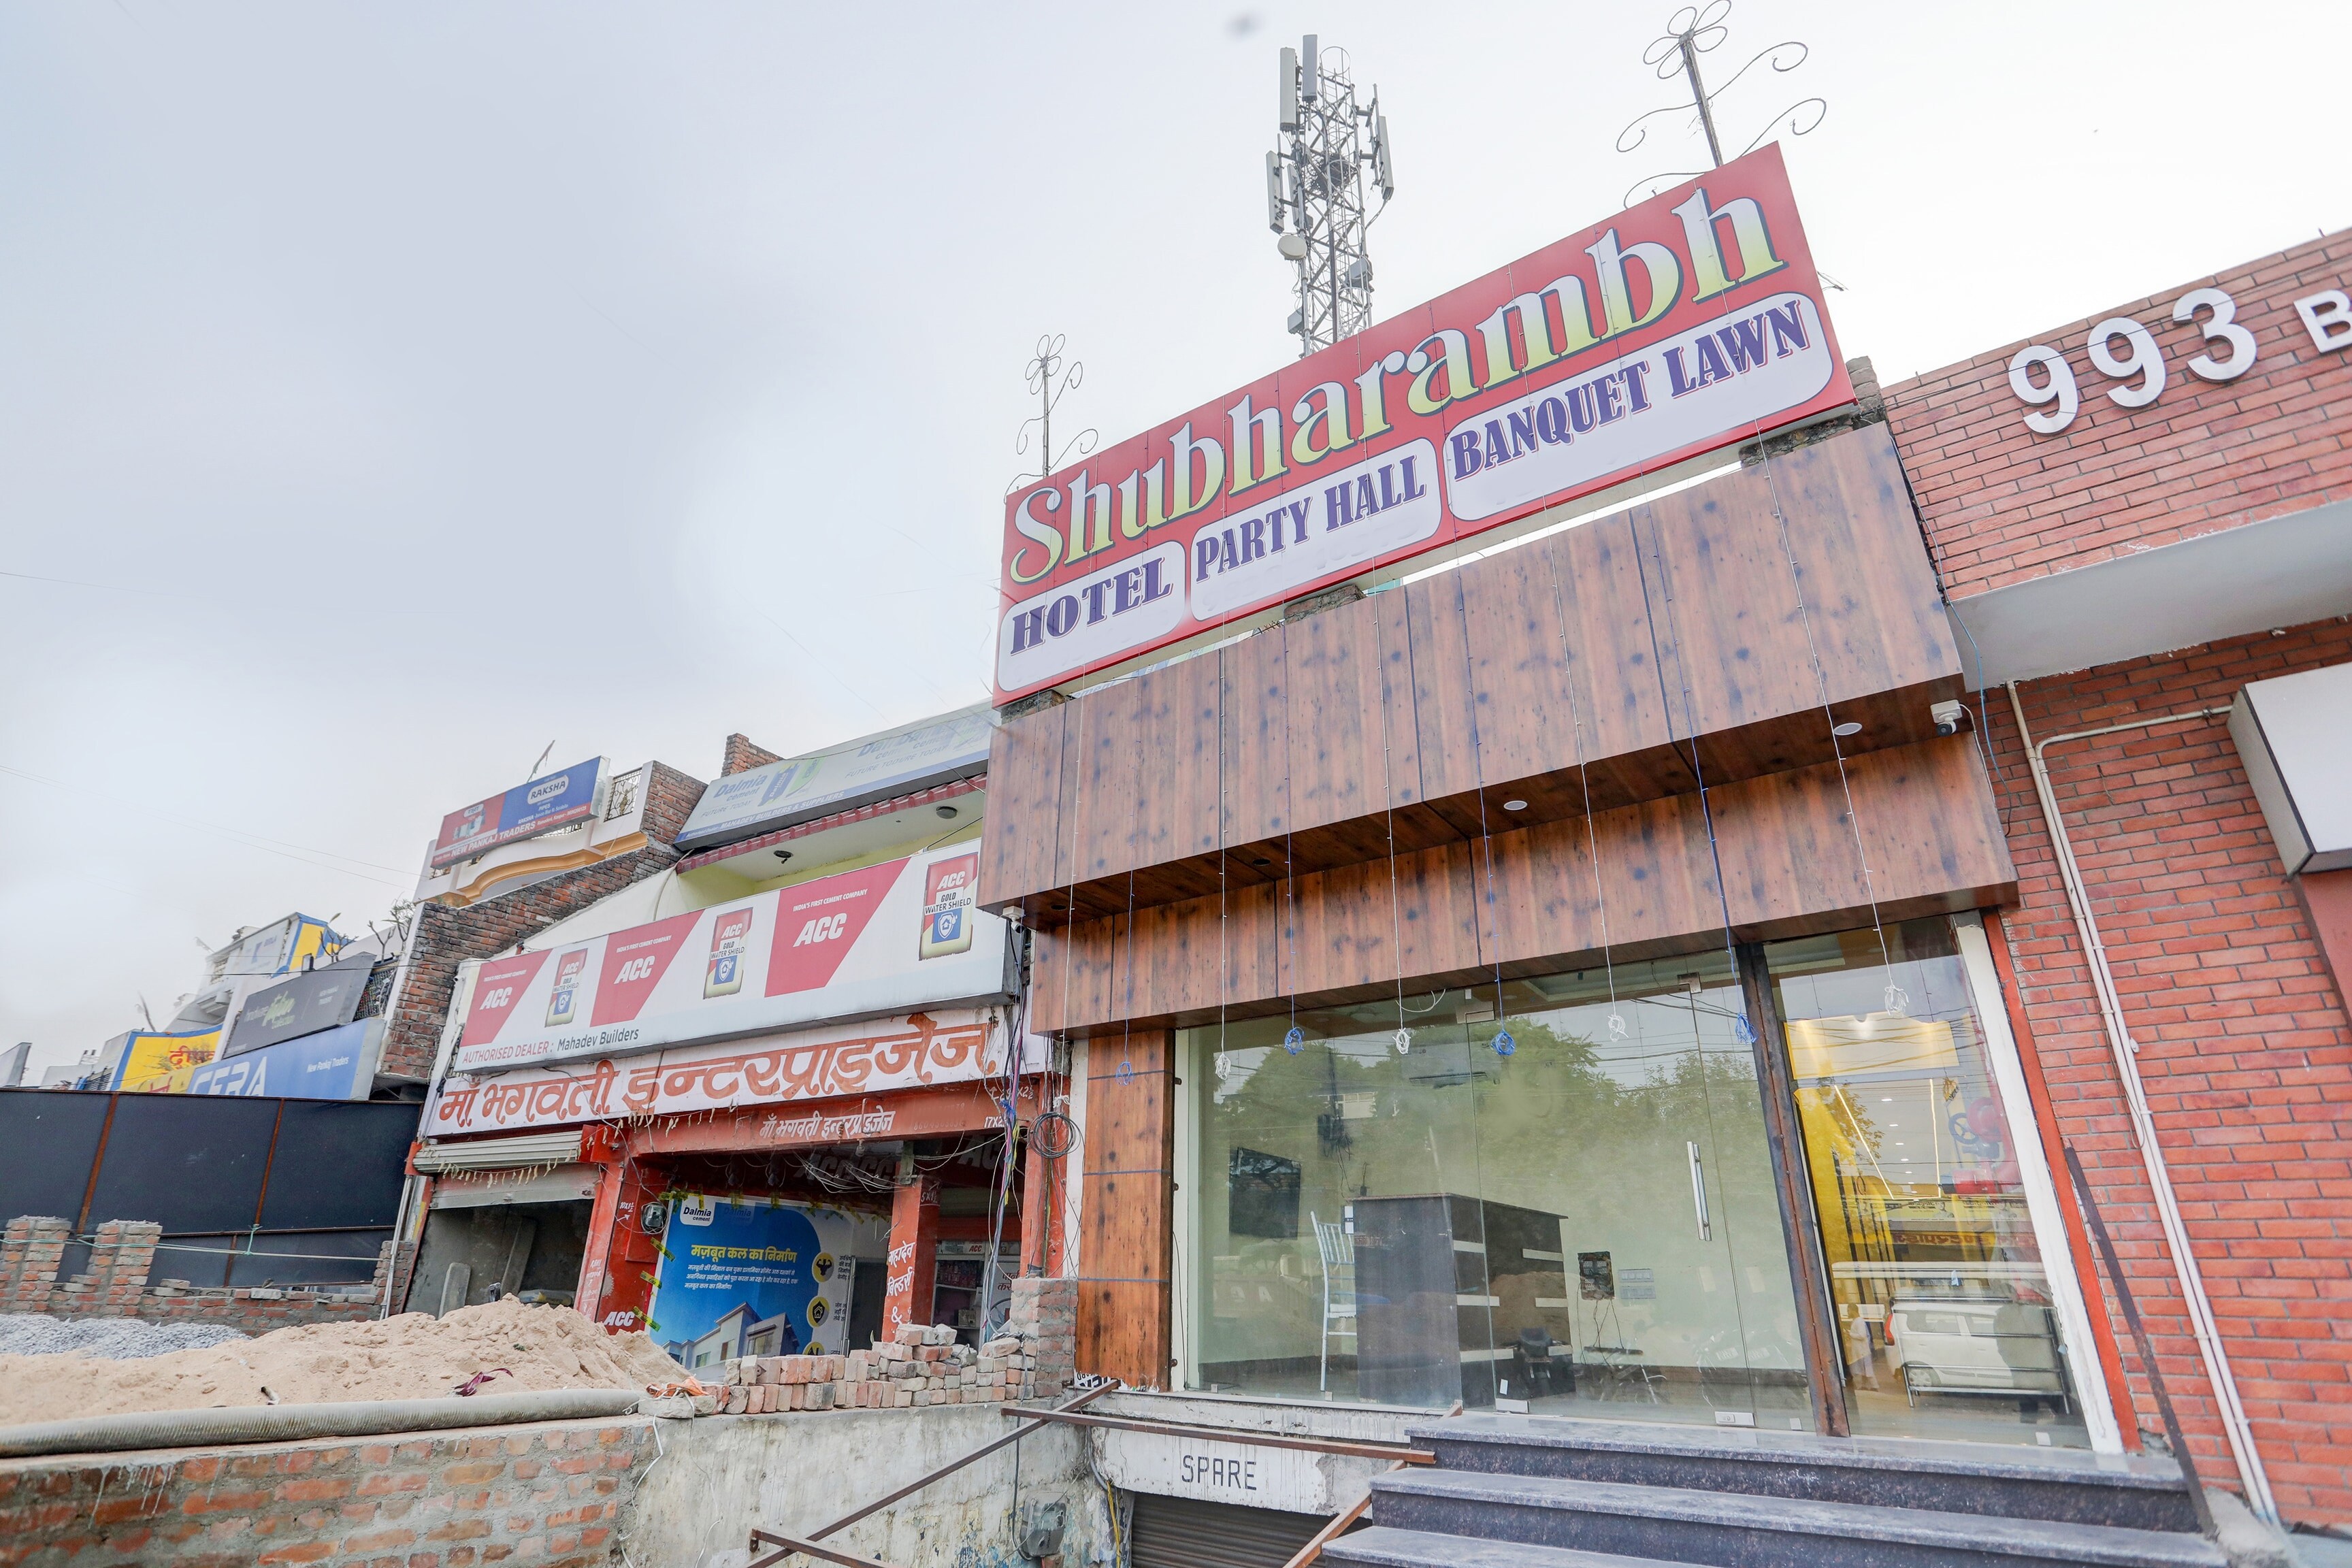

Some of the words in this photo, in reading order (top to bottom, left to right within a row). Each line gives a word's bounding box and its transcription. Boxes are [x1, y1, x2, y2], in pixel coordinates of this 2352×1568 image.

[2008, 287, 2258, 436] 993
[1009, 188, 1788, 586] Shubharambh
[1454, 361, 1652, 482] BANQUET
[1662, 298, 1812, 397] LAWN
[1196, 496, 1312, 583] PARTY
[1324, 455, 1427, 533] HALL
[1010, 555, 1173, 656] HOTEL
[531, 781, 566, 799] RAKSHA
[713, 774, 768, 798] Dalmia
[727, 787, 760, 802] cement
[720, 815, 755, 829] MAHADEV
[755, 805, 791, 820] BUILDERS
[800, 791, 844, 808] SUPPLIERS
[451, 844, 468, 857] NEW
[468, 834, 497, 851] PANKAJ
[499, 821, 536, 840] TRADERS
[937, 870, 966, 890] ACC
[793, 902, 811, 912] INDIA'S
[811, 898, 823, 907] FIRST
[823, 894, 843, 905] CEMENT
[843, 888, 868, 900] COMPANY
[925, 902, 947, 915] WATER
[948, 896, 972, 910] SHIELD
[940, 892, 957, 902] GOLD
[653, 934, 672, 945] COMPANY
[721, 923, 743, 938] ACC
[793, 913, 847, 948] ACC
[711, 951, 727, 960] WATER
[728, 947, 745, 956] SHIELD
[723, 941, 735, 949] GOLD
[562, 962, 579, 975] ACC
[613, 955, 655, 984] ACC
[479, 987, 512, 1010] ACC
[463, 1045, 514, 1064] AUTHORISED
[515, 1041, 549, 1057] DEALER
[557, 1036, 598, 1052] Mahadev
[600, 1028, 639, 1043] Builders
[191, 1056, 267, 1096] CERA
[307, 1063, 316, 1073] New
[316, 1060, 331, 1071] Pankaj
[332, 1056, 349, 1067] Traders
[482, 1058, 620, 1125] भगवती
[776, 1110, 823, 1141] भगवती
[683, 1207, 711, 1217] Dalmia
[691, 1245, 726, 1262] मज़बूत
[728, 1247, 748, 1260] कल
[749, 1248, 764, 1260] का
[764, 1245, 798, 1263] निर्माण
[888, 1241, 915, 1268] महादेव
[887, 1267, 913, 1296] बिल्डर्स
[604, 1311, 636, 1326] ACC
[891, 1305, 902, 1324] &
[1181, 1454, 1257, 1490] SPARE
